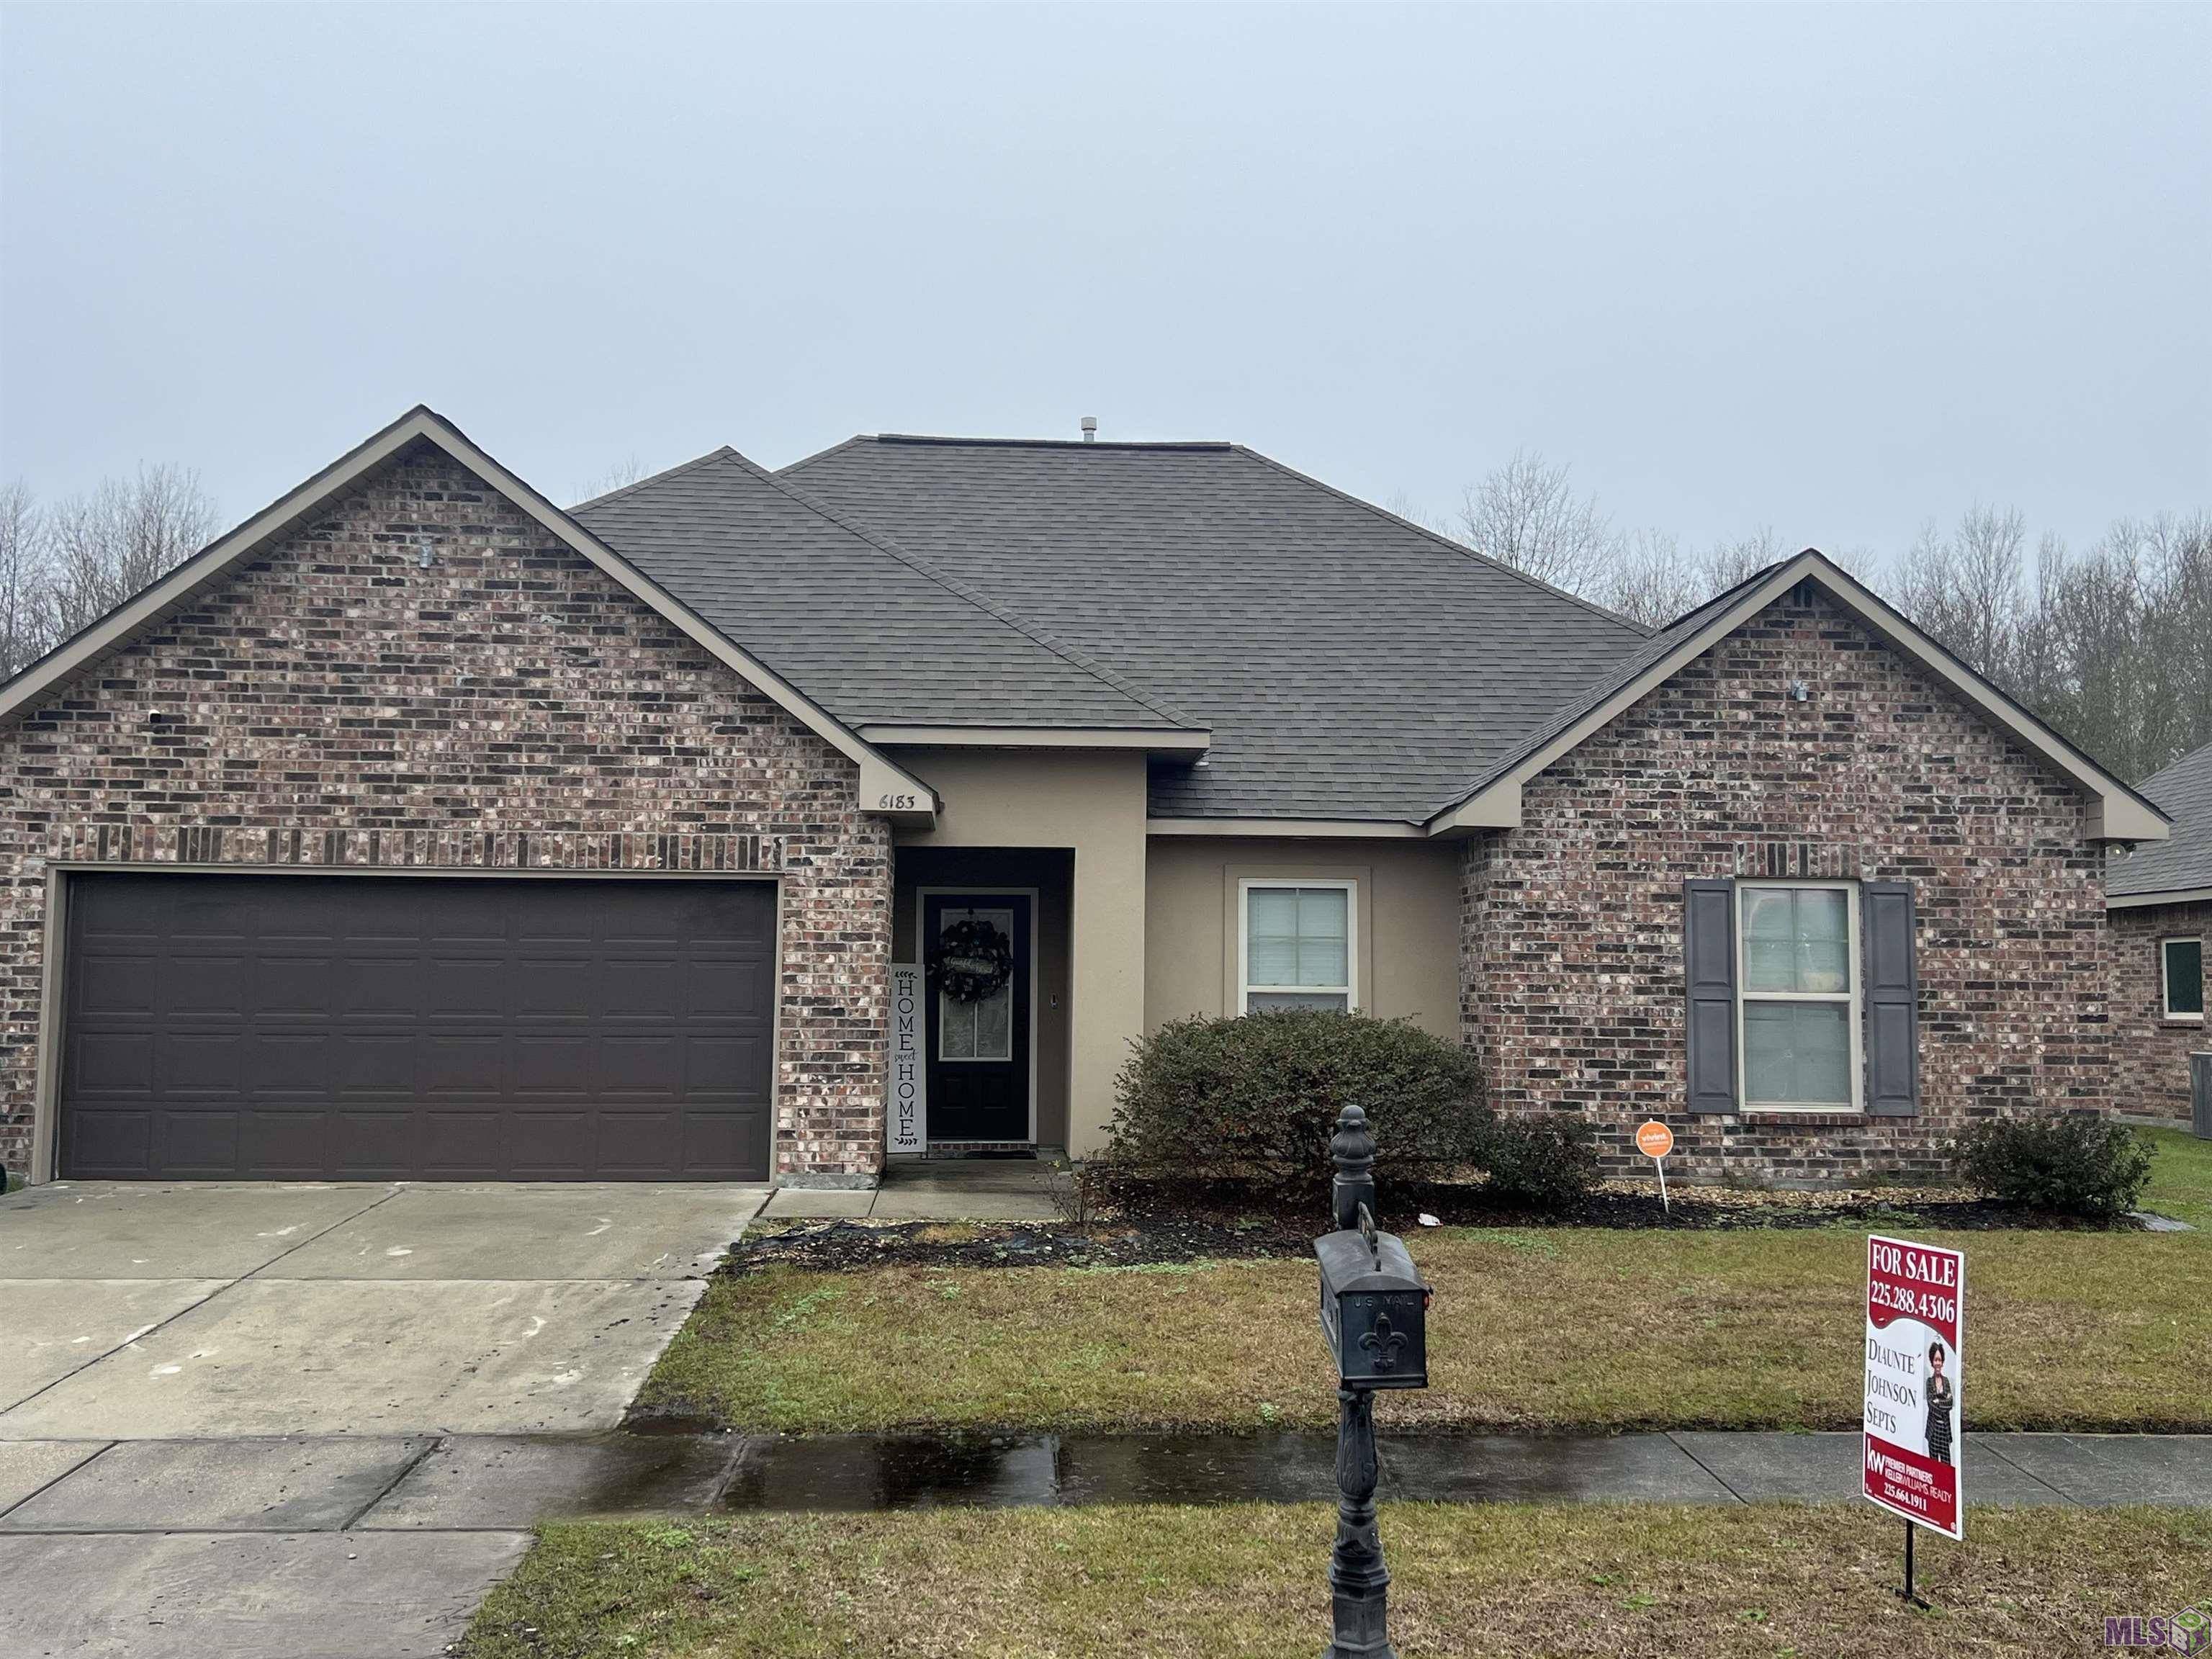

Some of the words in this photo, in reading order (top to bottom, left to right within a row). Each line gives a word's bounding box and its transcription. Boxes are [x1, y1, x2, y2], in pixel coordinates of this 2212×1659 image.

[879, 794, 914, 809] 6183
[898, 980, 914, 1051] HOME
[898, 1064, 914, 1136] HOME
[1872, 1244, 1902, 1277] FOR
[1906, 1251, 1956, 1287] SALE
[1354, 1295, 1373, 1308] US
[1871, 1280, 1955, 1323] 225.288.4306
